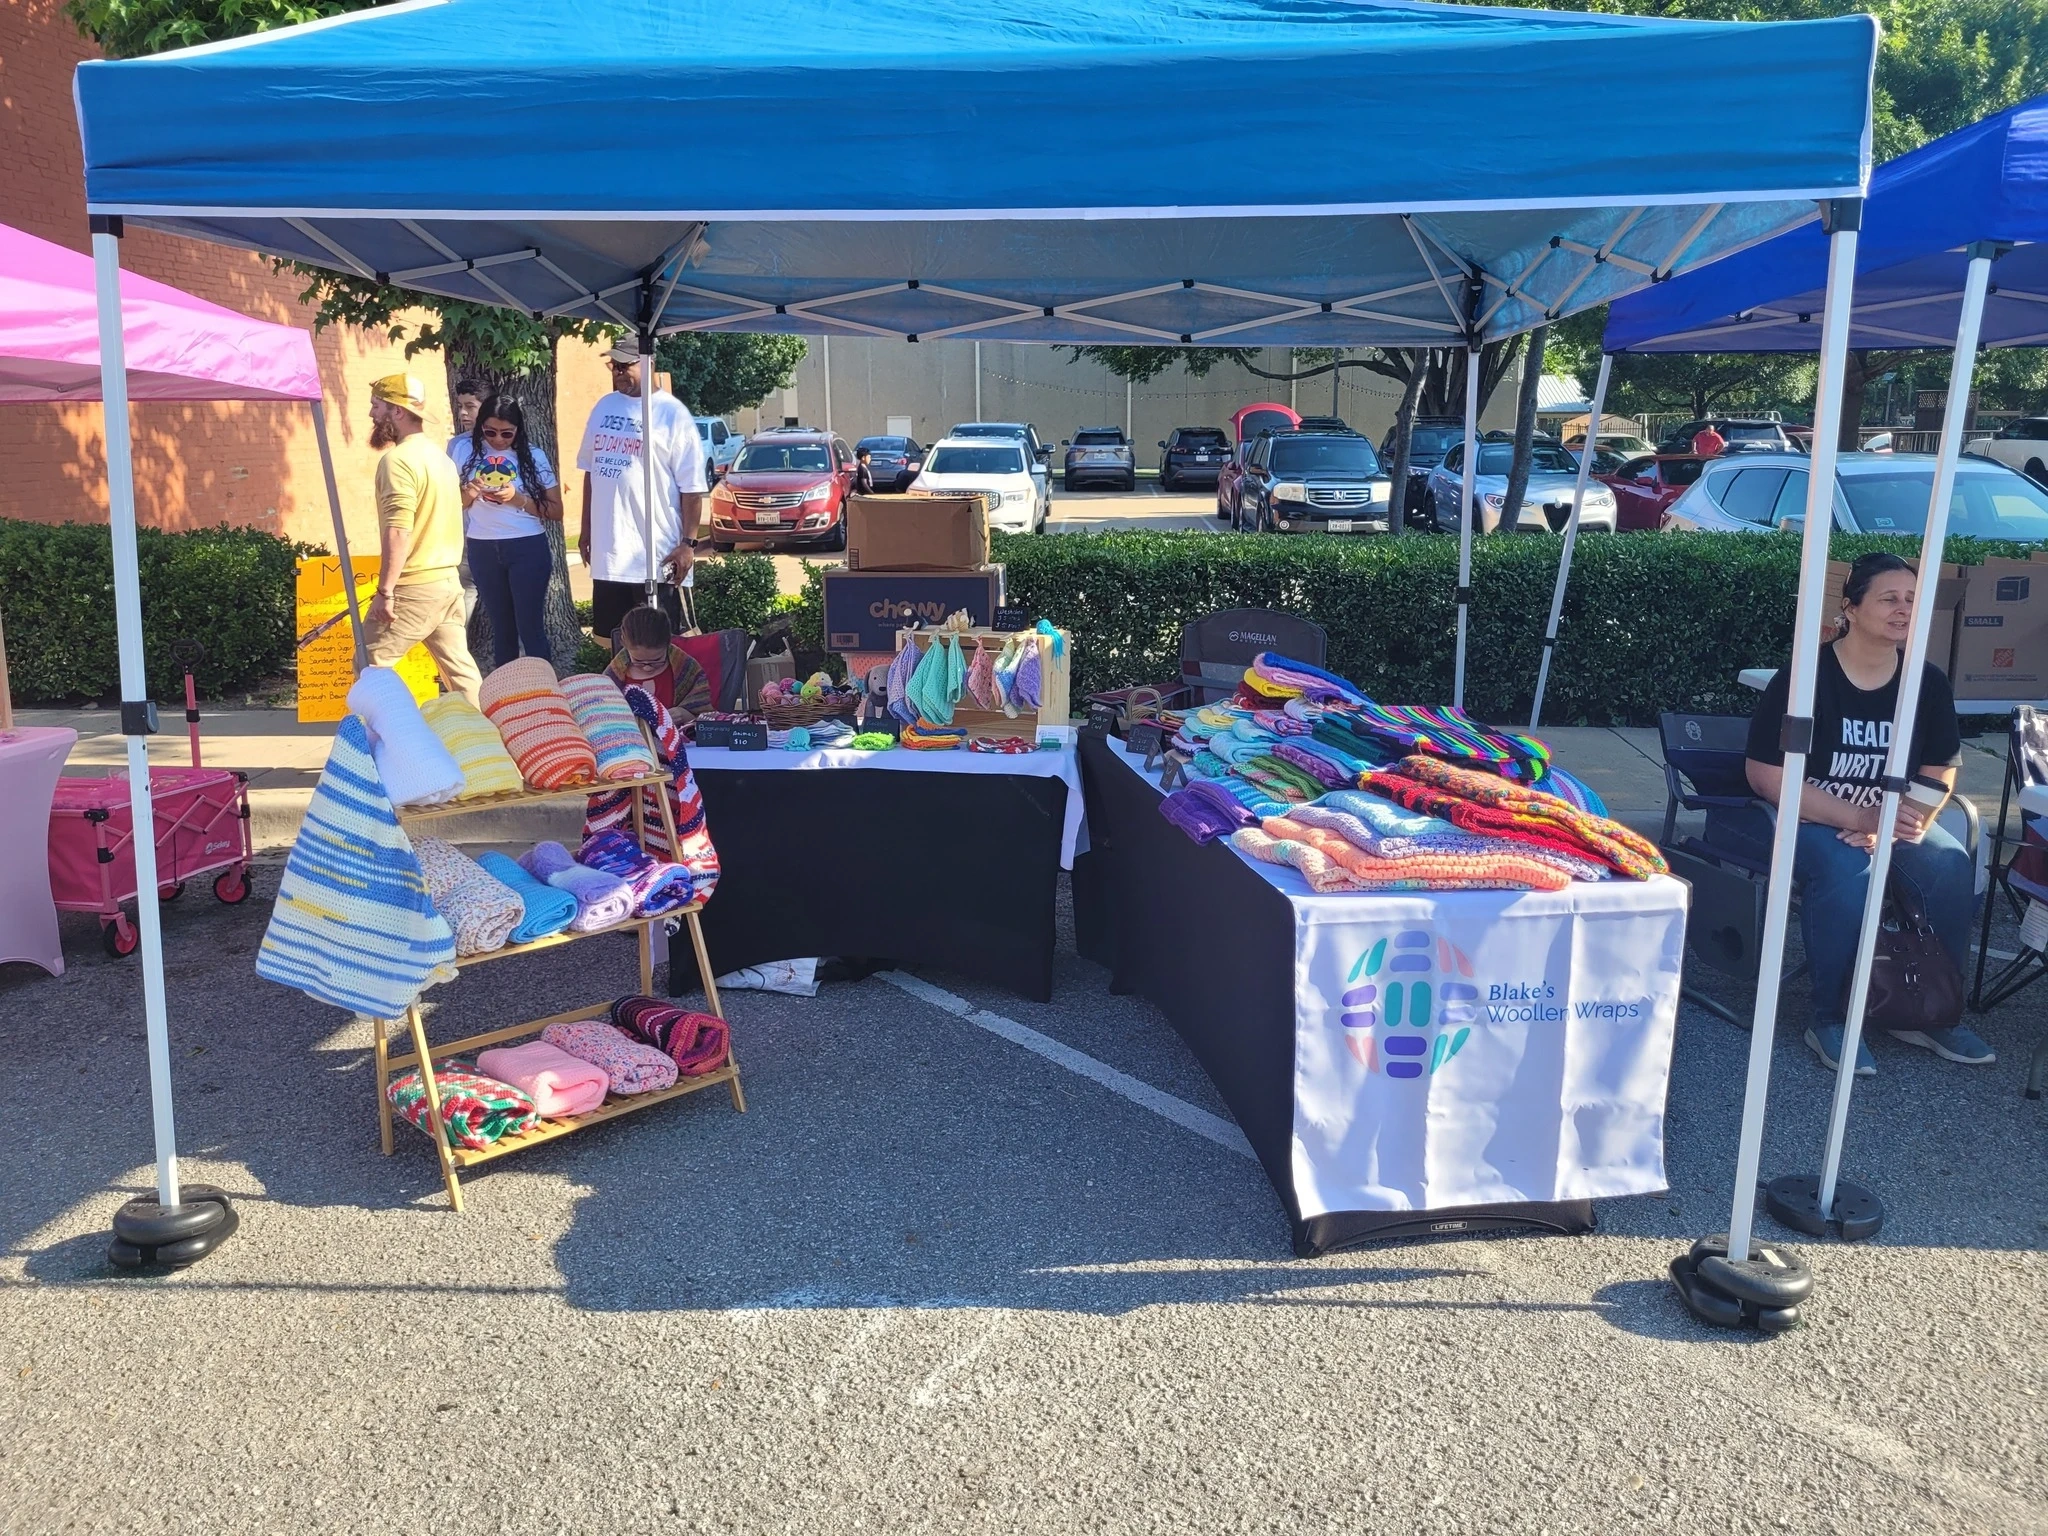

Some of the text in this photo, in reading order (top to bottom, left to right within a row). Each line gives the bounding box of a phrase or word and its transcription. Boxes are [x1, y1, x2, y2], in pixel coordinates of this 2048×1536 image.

[600, 415, 625, 431] DOES
[606, 436, 621, 453] DAY
[622, 438, 644, 457] SHIRT
[600, 467, 622, 479] FAST?
[614, 459, 631, 468] LOOK
[322, 563, 380, 586] Men
[869, 598, 946, 622] chewy
[1240, 631, 1277, 642] MAGELLAN
[732, 730, 758, 738] Animals
[1842, 717, 1894, 747] READ
[1828, 751, 1886, 780] WRIT
[1806, 776, 1884, 808] SCUS
[1488, 980, 1555, 1001] Blake's
[1574, 1001, 1640, 1023] Wraps
